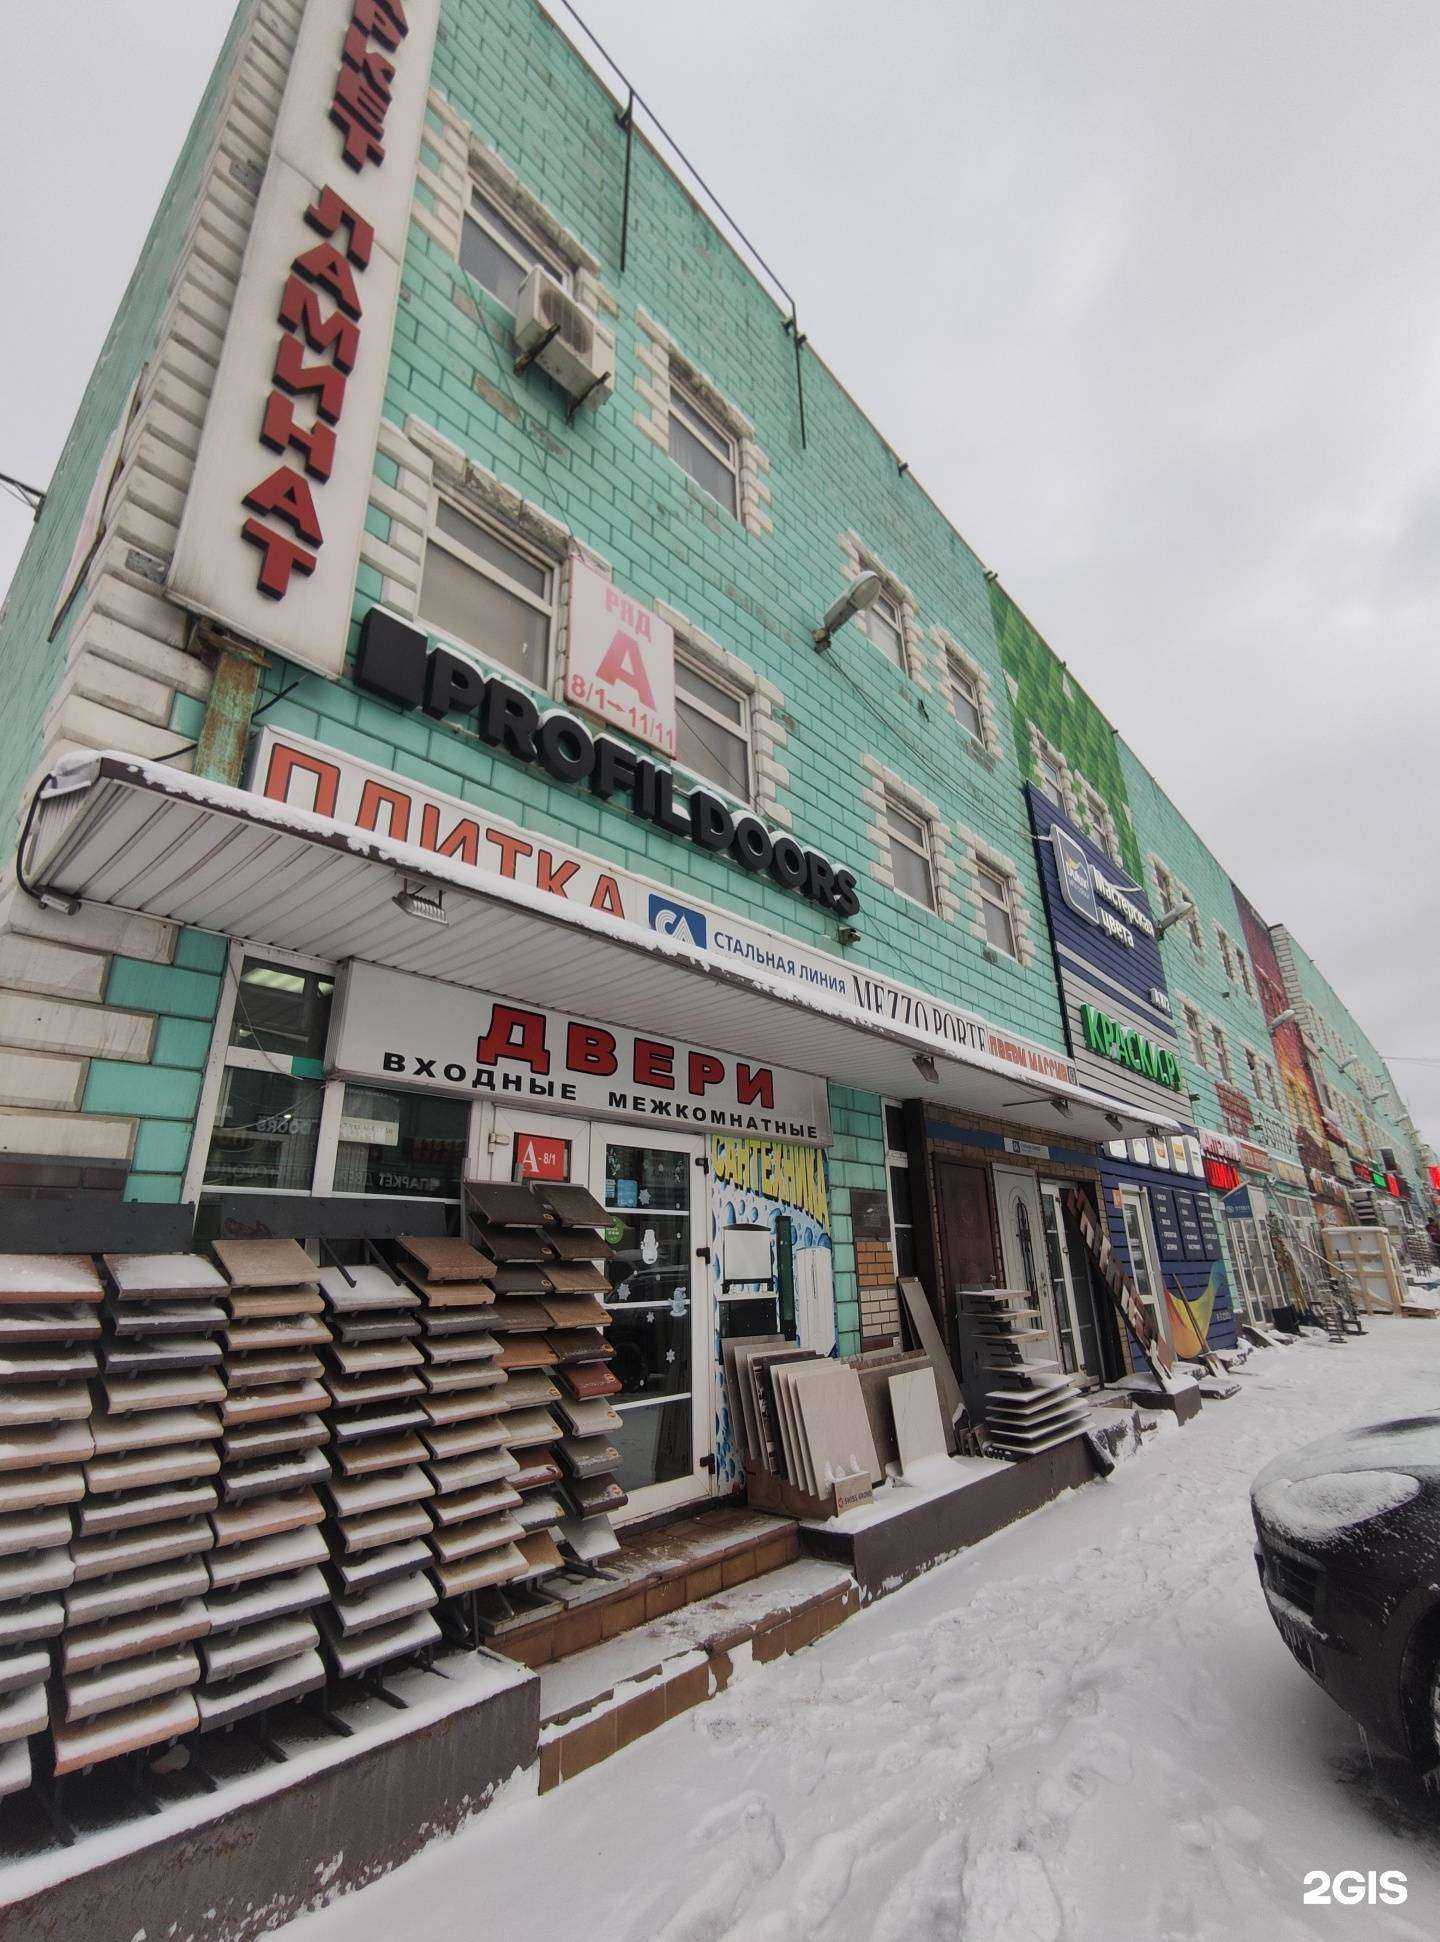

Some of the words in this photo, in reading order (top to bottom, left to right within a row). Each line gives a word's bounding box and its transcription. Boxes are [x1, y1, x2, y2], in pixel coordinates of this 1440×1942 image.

[241, 184, 375, 600] ЛАМИНАТ
[605, 584, 653, 643] РЯД
[595, 629, 658, 713] А
[713, 930, 796, 975] СТАЛЬНАЯ
[799, 964, 847, 995] ЛИНИЯ
[382, 1051, 578, 1101] ВХОДНЫЕ
[608, 1091, 819, 1139] МЕЖКОМНАТНЫЕ
[476, 1002, 775, 1109] ДВЕРИ
